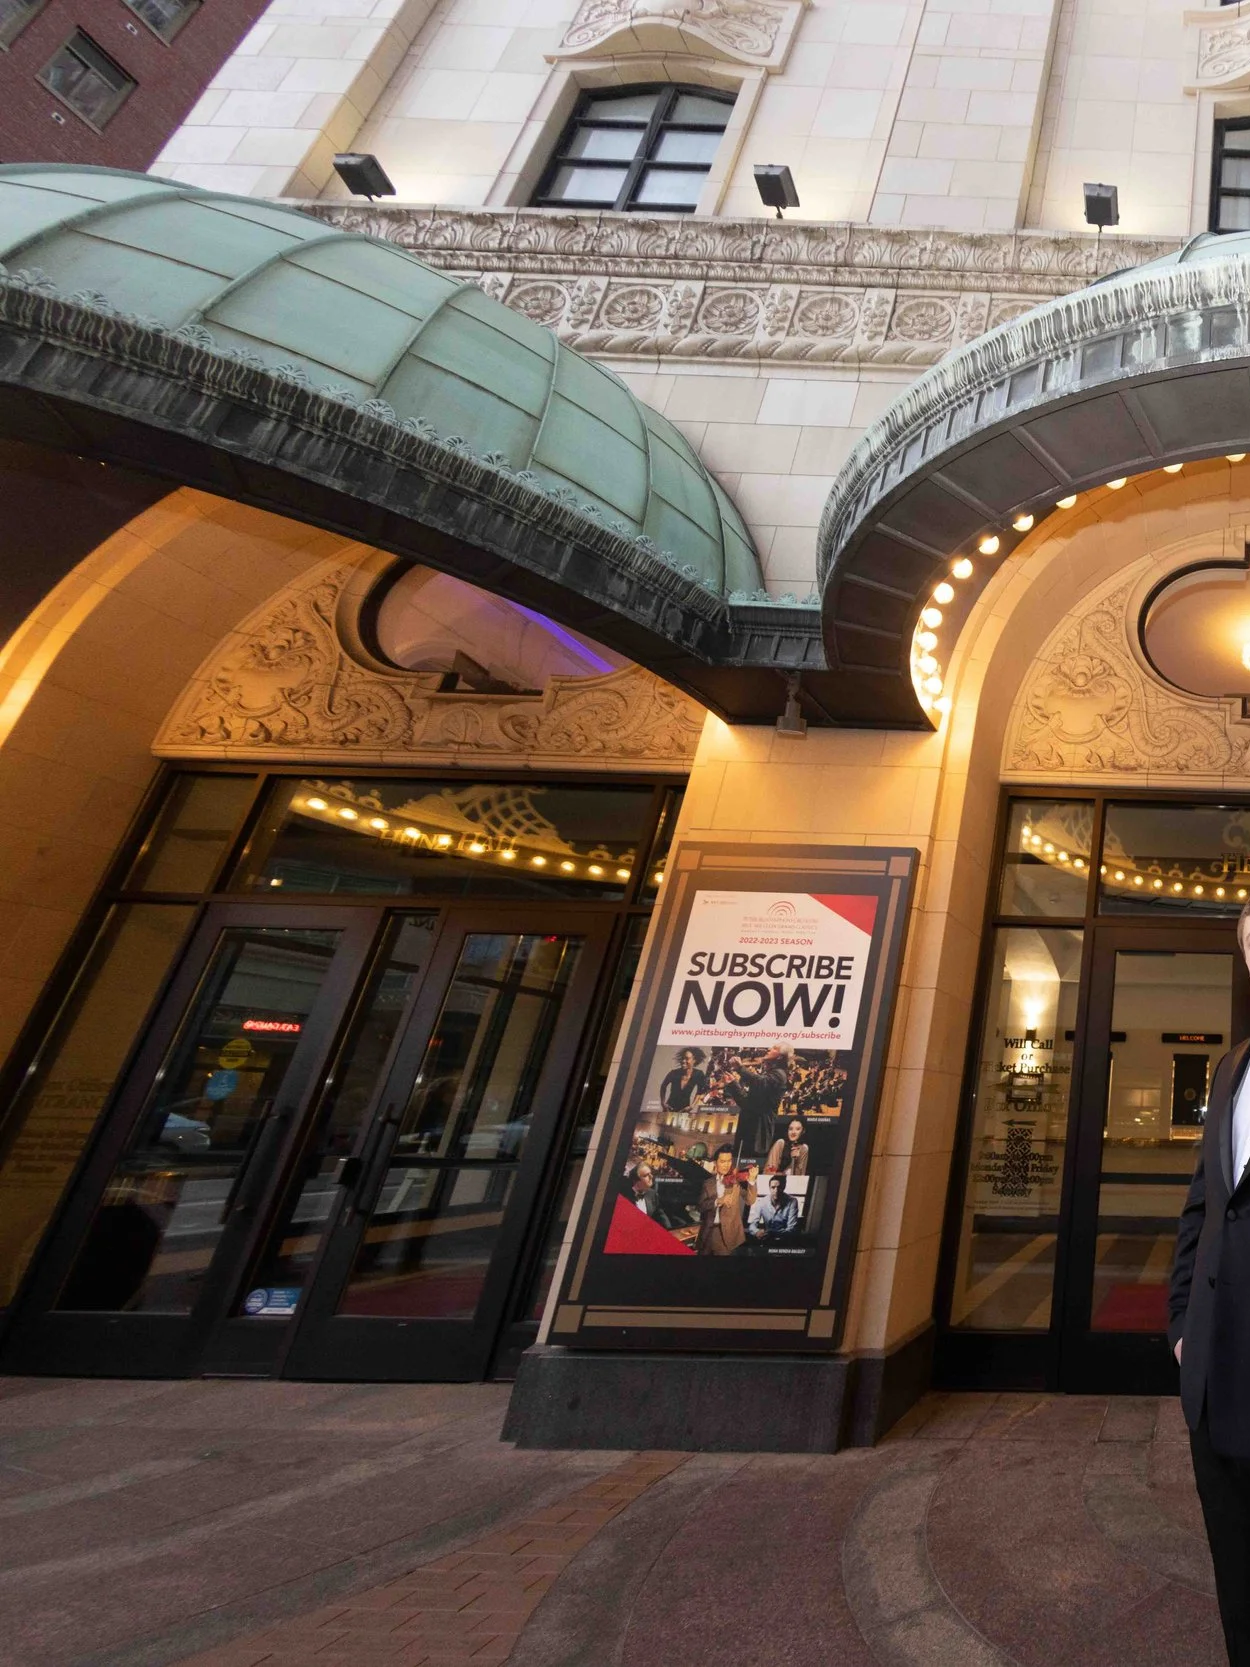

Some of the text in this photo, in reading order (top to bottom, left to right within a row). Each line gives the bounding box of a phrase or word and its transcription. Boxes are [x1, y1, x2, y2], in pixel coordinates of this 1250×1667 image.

[739, 936, 813, 946] 2022-2023 SEASON
[687, 951, 855, 980] SUBSCRIBE
[674, 979, 847, 1029] NOW!
[671, 1028, 842, 1041] www.pittsburghsymphony.org/subscribe
[1003, 1038, 1054, 1050] Will Call
[1021, 1053, 1034, 1061] or
